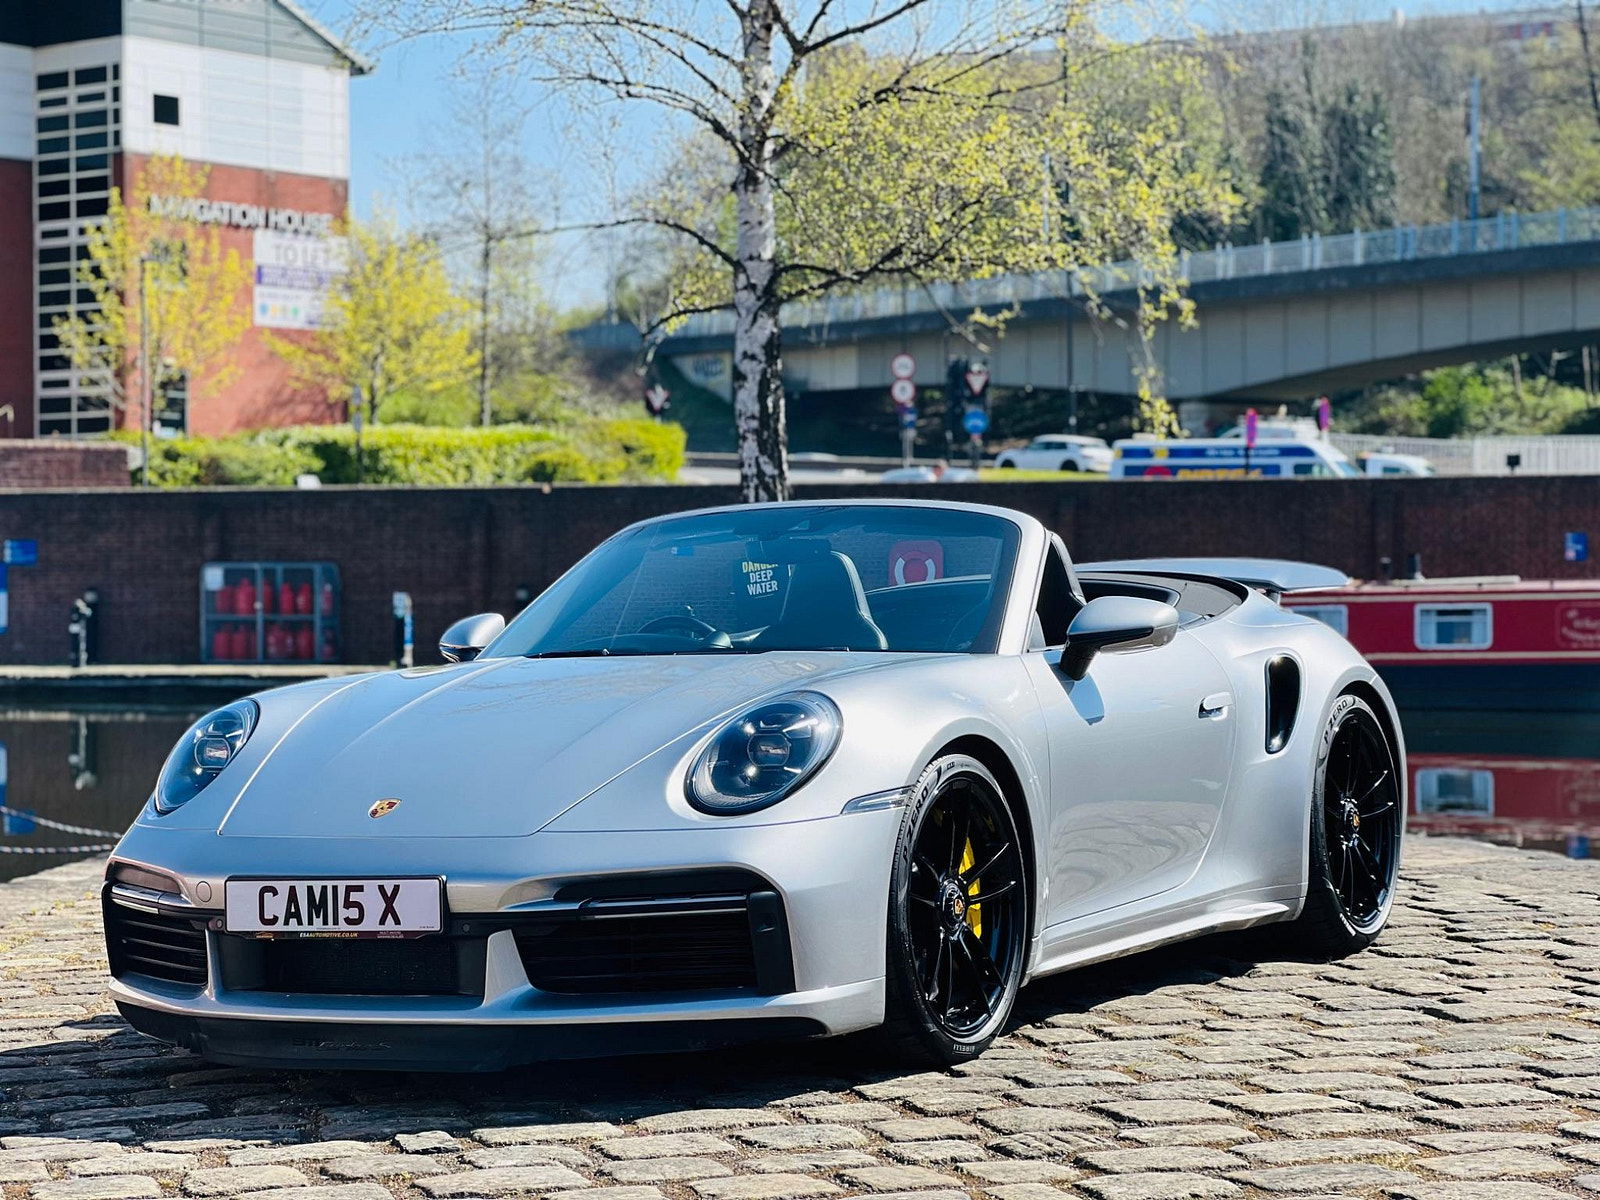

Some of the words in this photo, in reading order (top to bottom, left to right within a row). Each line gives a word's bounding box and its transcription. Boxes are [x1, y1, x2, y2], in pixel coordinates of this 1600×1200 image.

[148, 193, 266, 228] NAVIGATION
[267, 208, 333, 234] HOUSE
[747, 580, 778, 595] WATER
[749, 569, 773, 583] DEEP
[1327, 700, 1348, 731] ZERO
[906, 787, 929, 845] ZERO
[377, 884, 402, 926] X
[953, 1044, 975, 1052] PIRELLI
